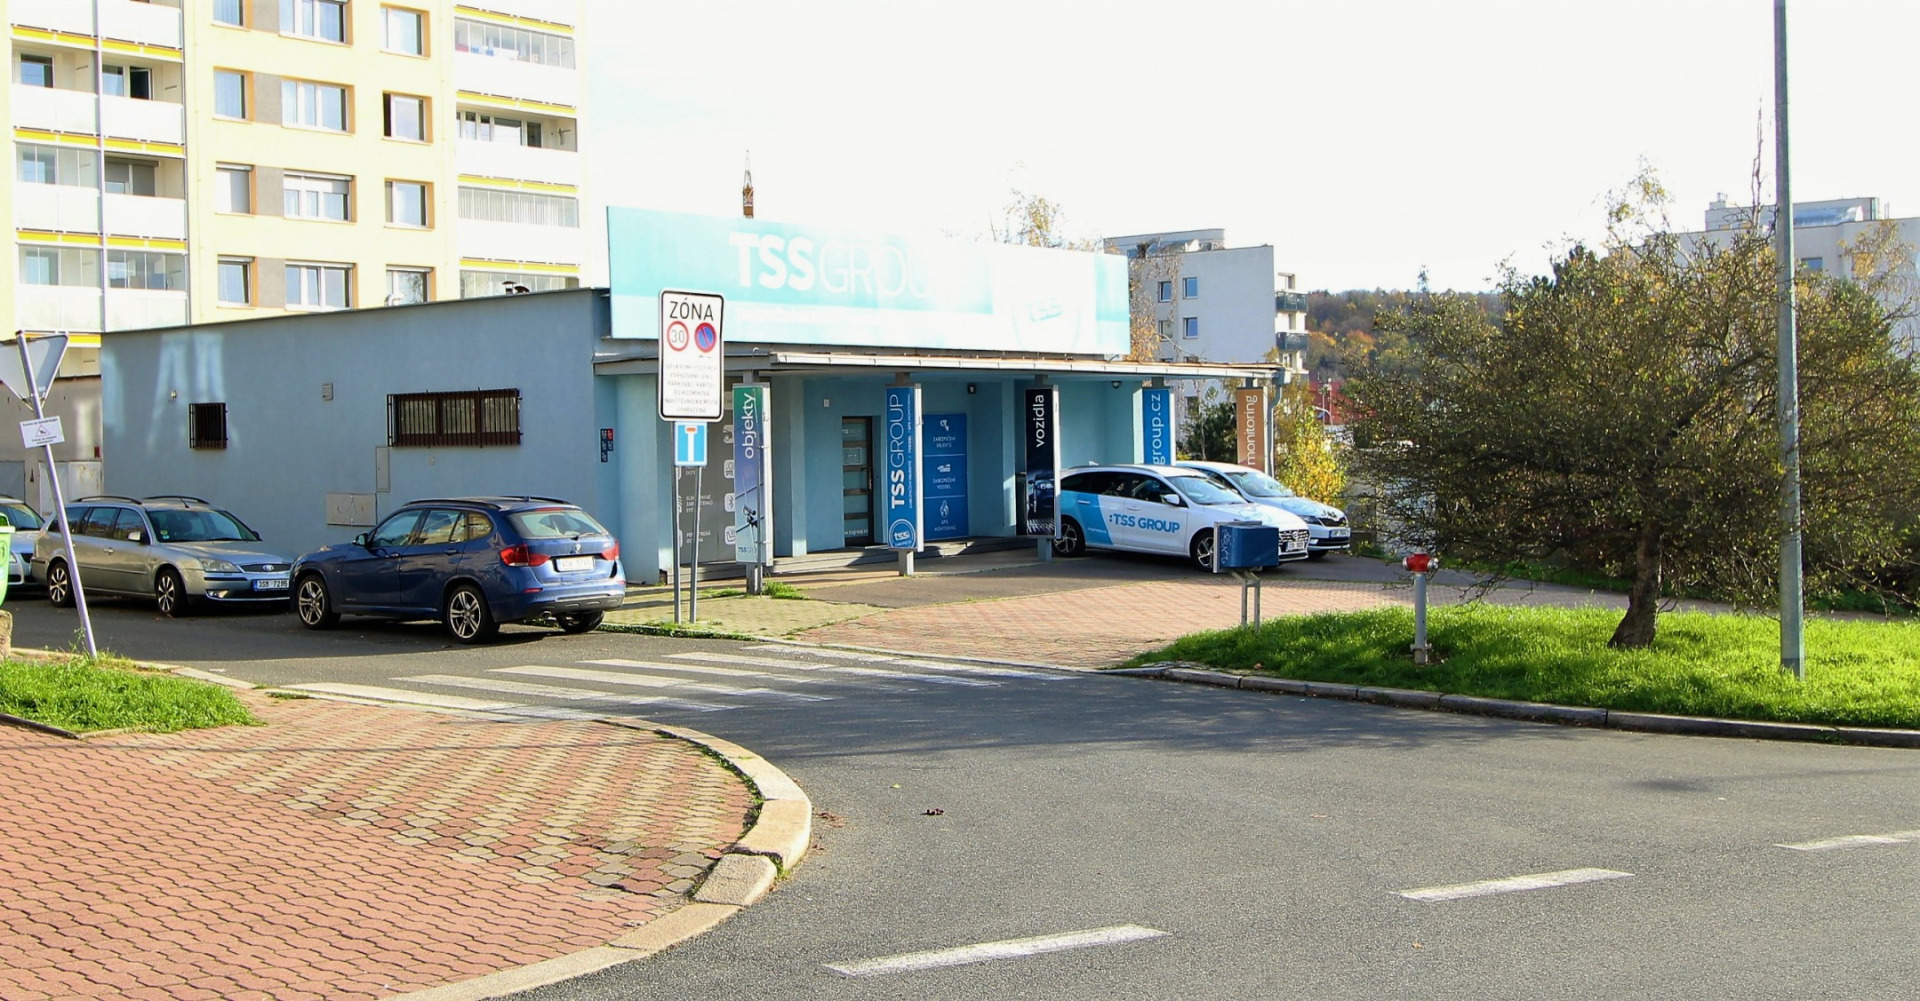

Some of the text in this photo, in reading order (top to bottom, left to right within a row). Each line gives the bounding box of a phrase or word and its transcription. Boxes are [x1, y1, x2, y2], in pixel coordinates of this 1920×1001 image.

[729, 231, 936, 298] TSSGROU
[669, 297, 714, 321] ZÓNA
[671, 329, 685, 343] 30
[741, 393, 757, 459] objekty
[1032, 394, 1045, 448] vozidla
[1244, 395, 1258, 466] monitoring
[1137, 517, 1180, 533] GROUP
